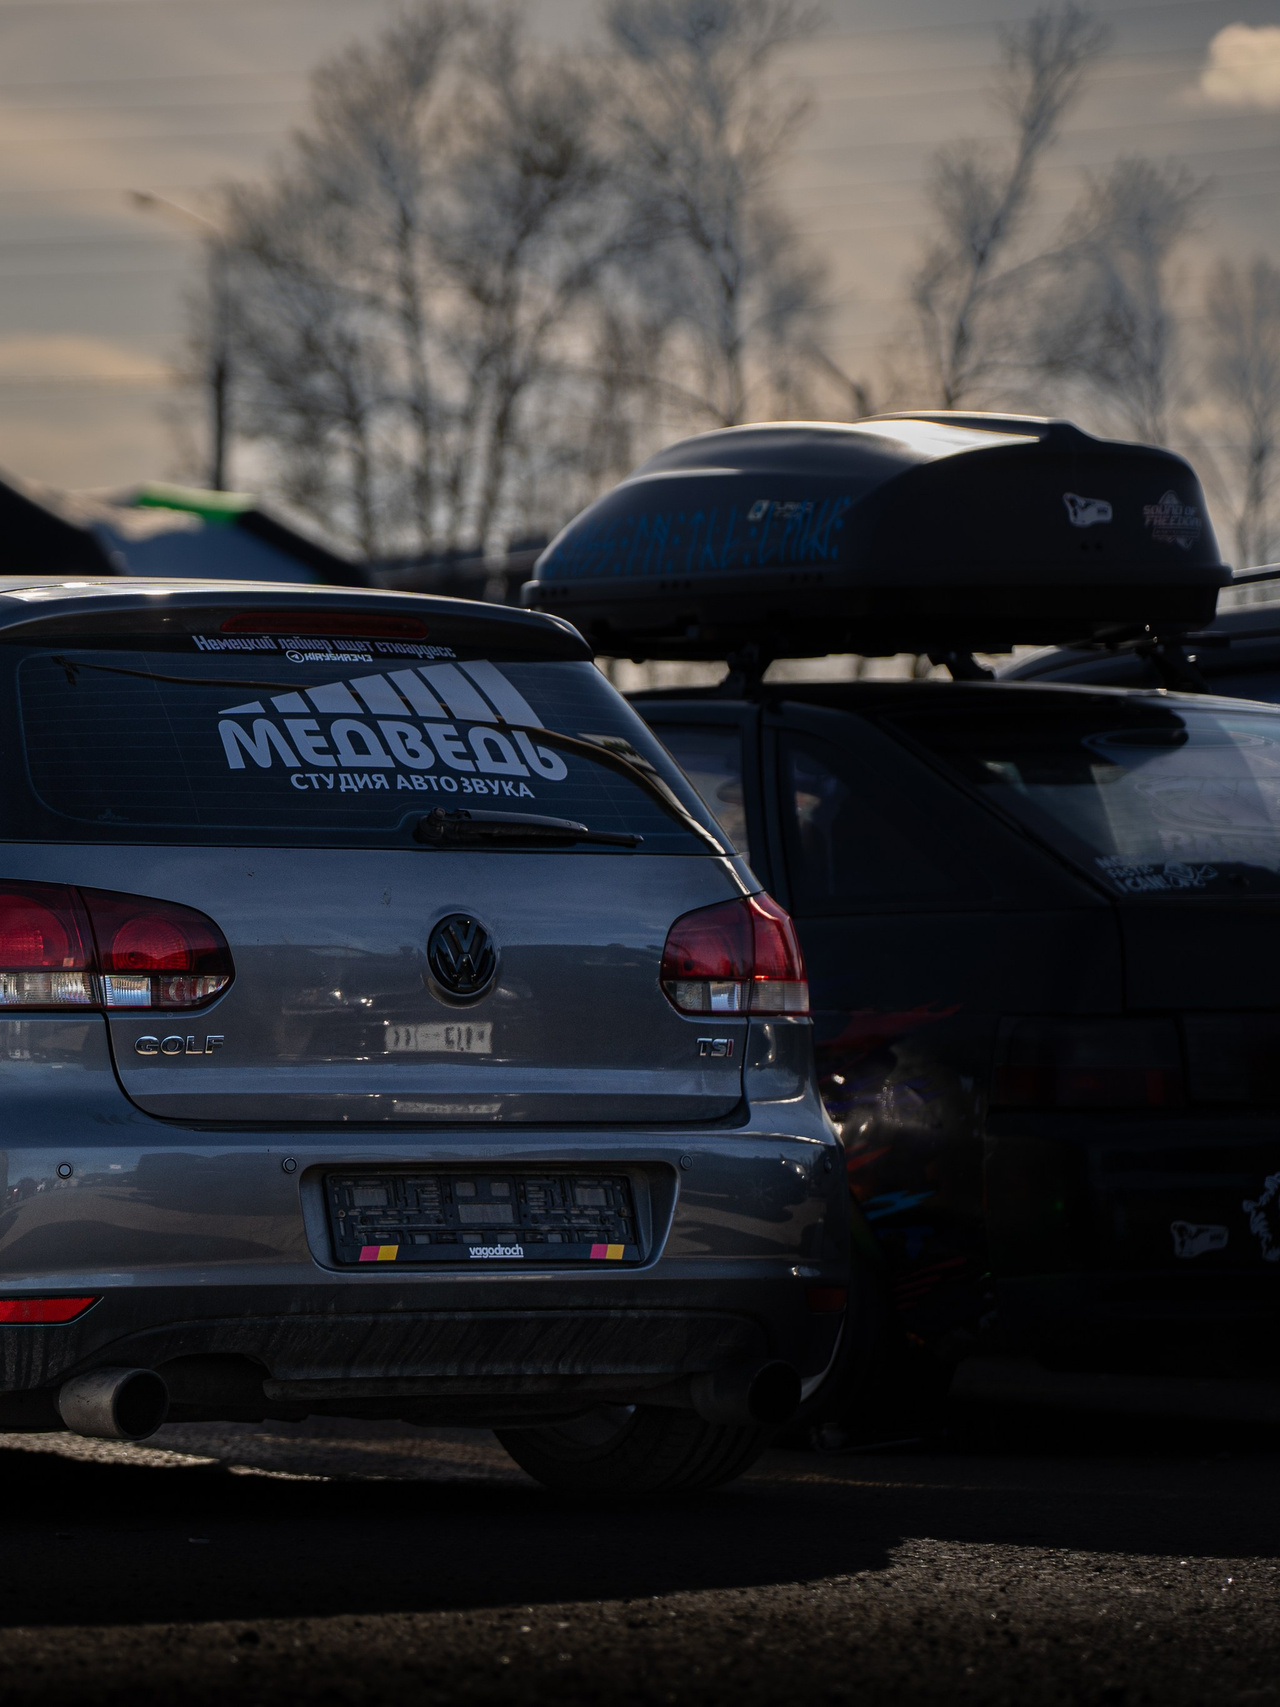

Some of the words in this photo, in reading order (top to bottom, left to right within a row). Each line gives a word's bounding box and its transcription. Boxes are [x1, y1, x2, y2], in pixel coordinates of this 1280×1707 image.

[191, 635, 275, 652] Немецкий
[277, 636, 331, 654] лайнер
[331, 639, 375, 654] ищет
[372, 641, 457, 660] стюардесс
[217, 718, 569, 782] МЕДВЕДЬ
[290, 773, 390, 793] СТУДИЯ
[134, 1035, 225, 1055] GOLF
[696, 1037, 735, 1057] TSI
[469, 1243, 524, 1258] vagodroch
